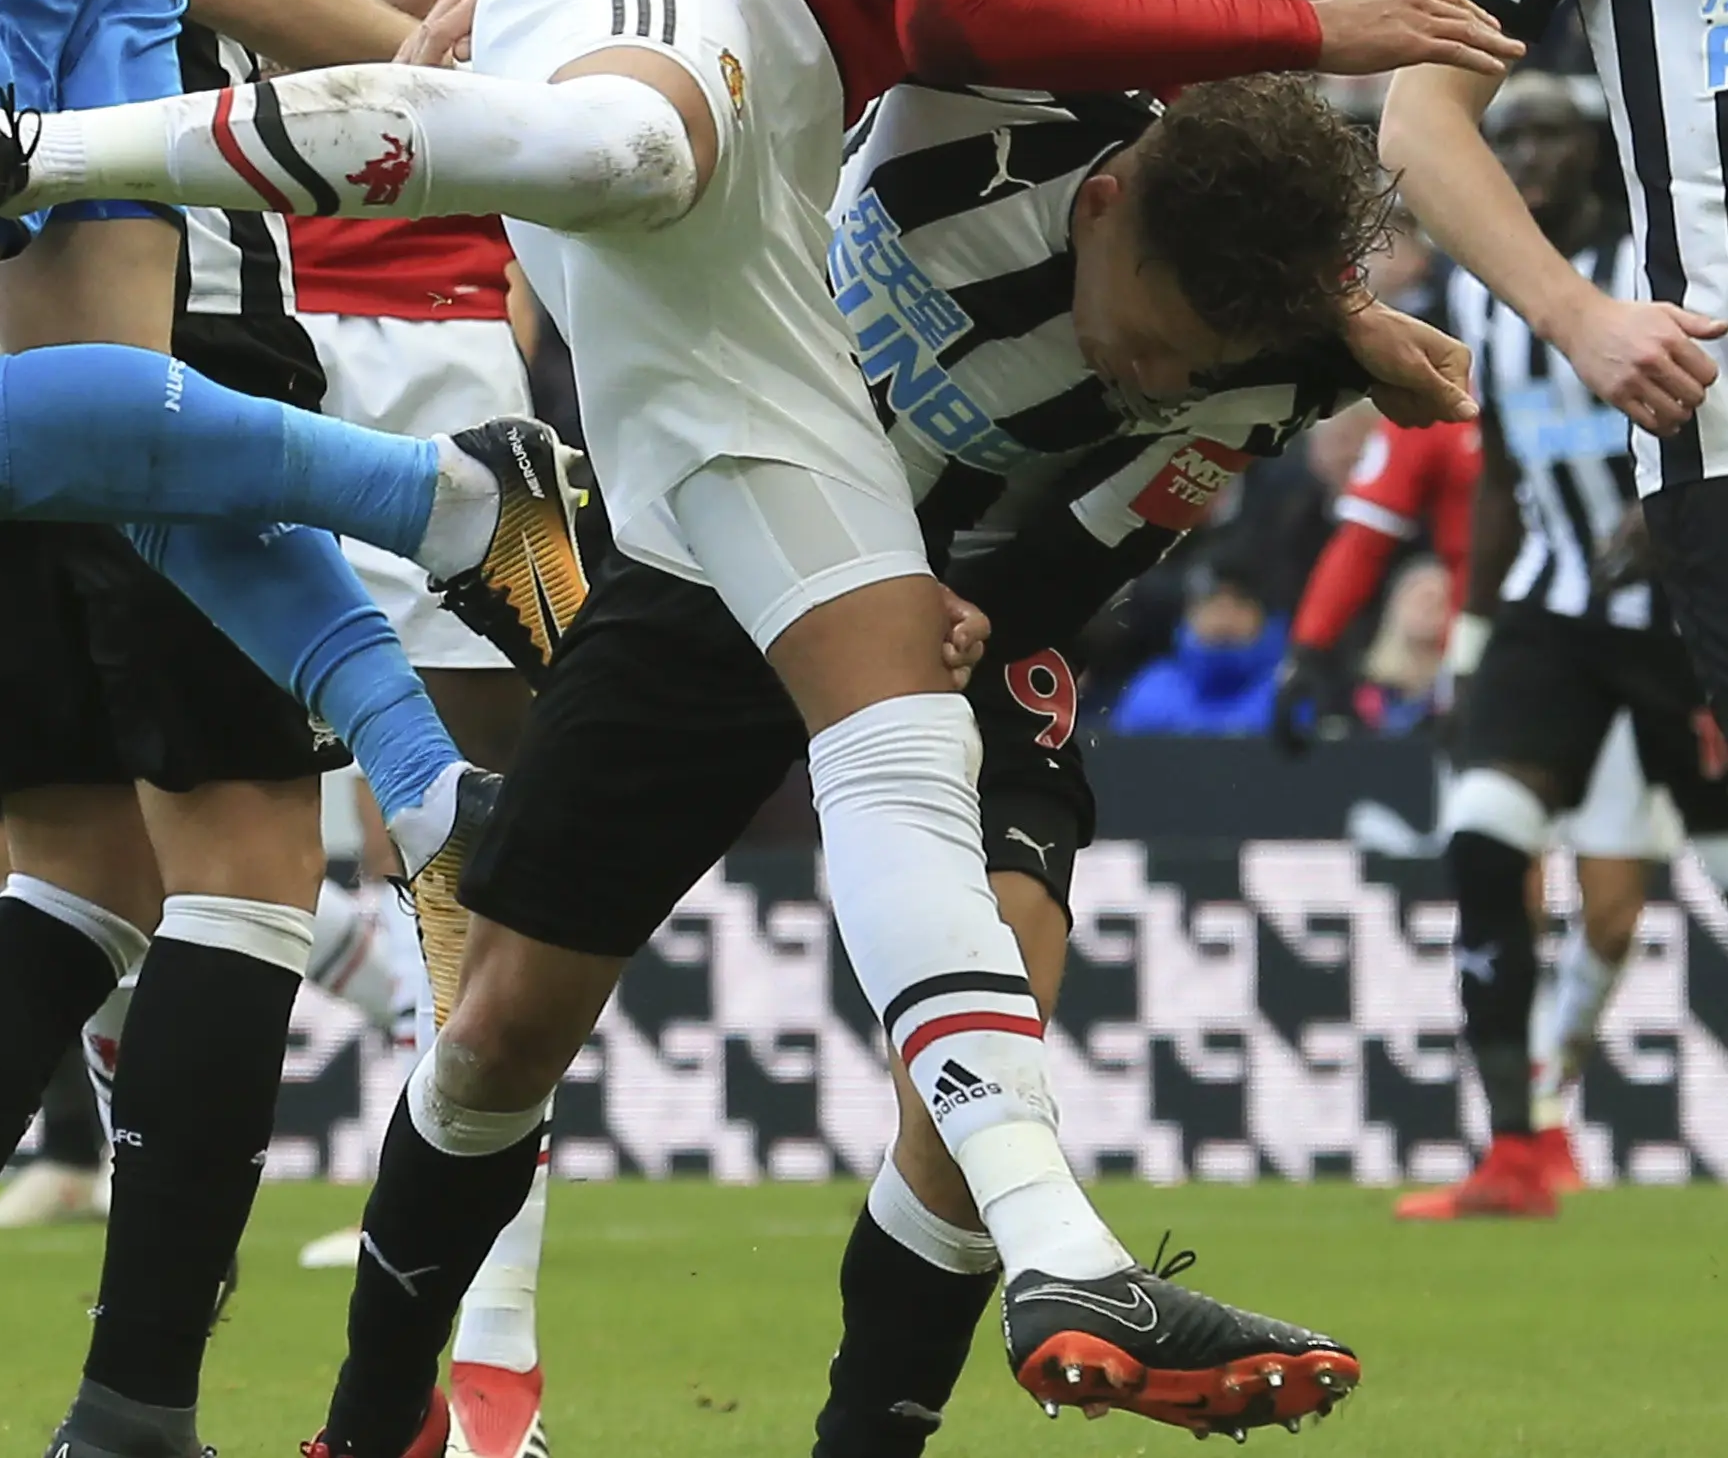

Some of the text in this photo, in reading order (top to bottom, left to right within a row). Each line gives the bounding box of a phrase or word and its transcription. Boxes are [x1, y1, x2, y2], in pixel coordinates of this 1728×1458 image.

[506, 426, 546, 499] MERCURIAL
[1004, 647, 1077, 751] 9
[934, 1082, 1003, 1124] adidas
